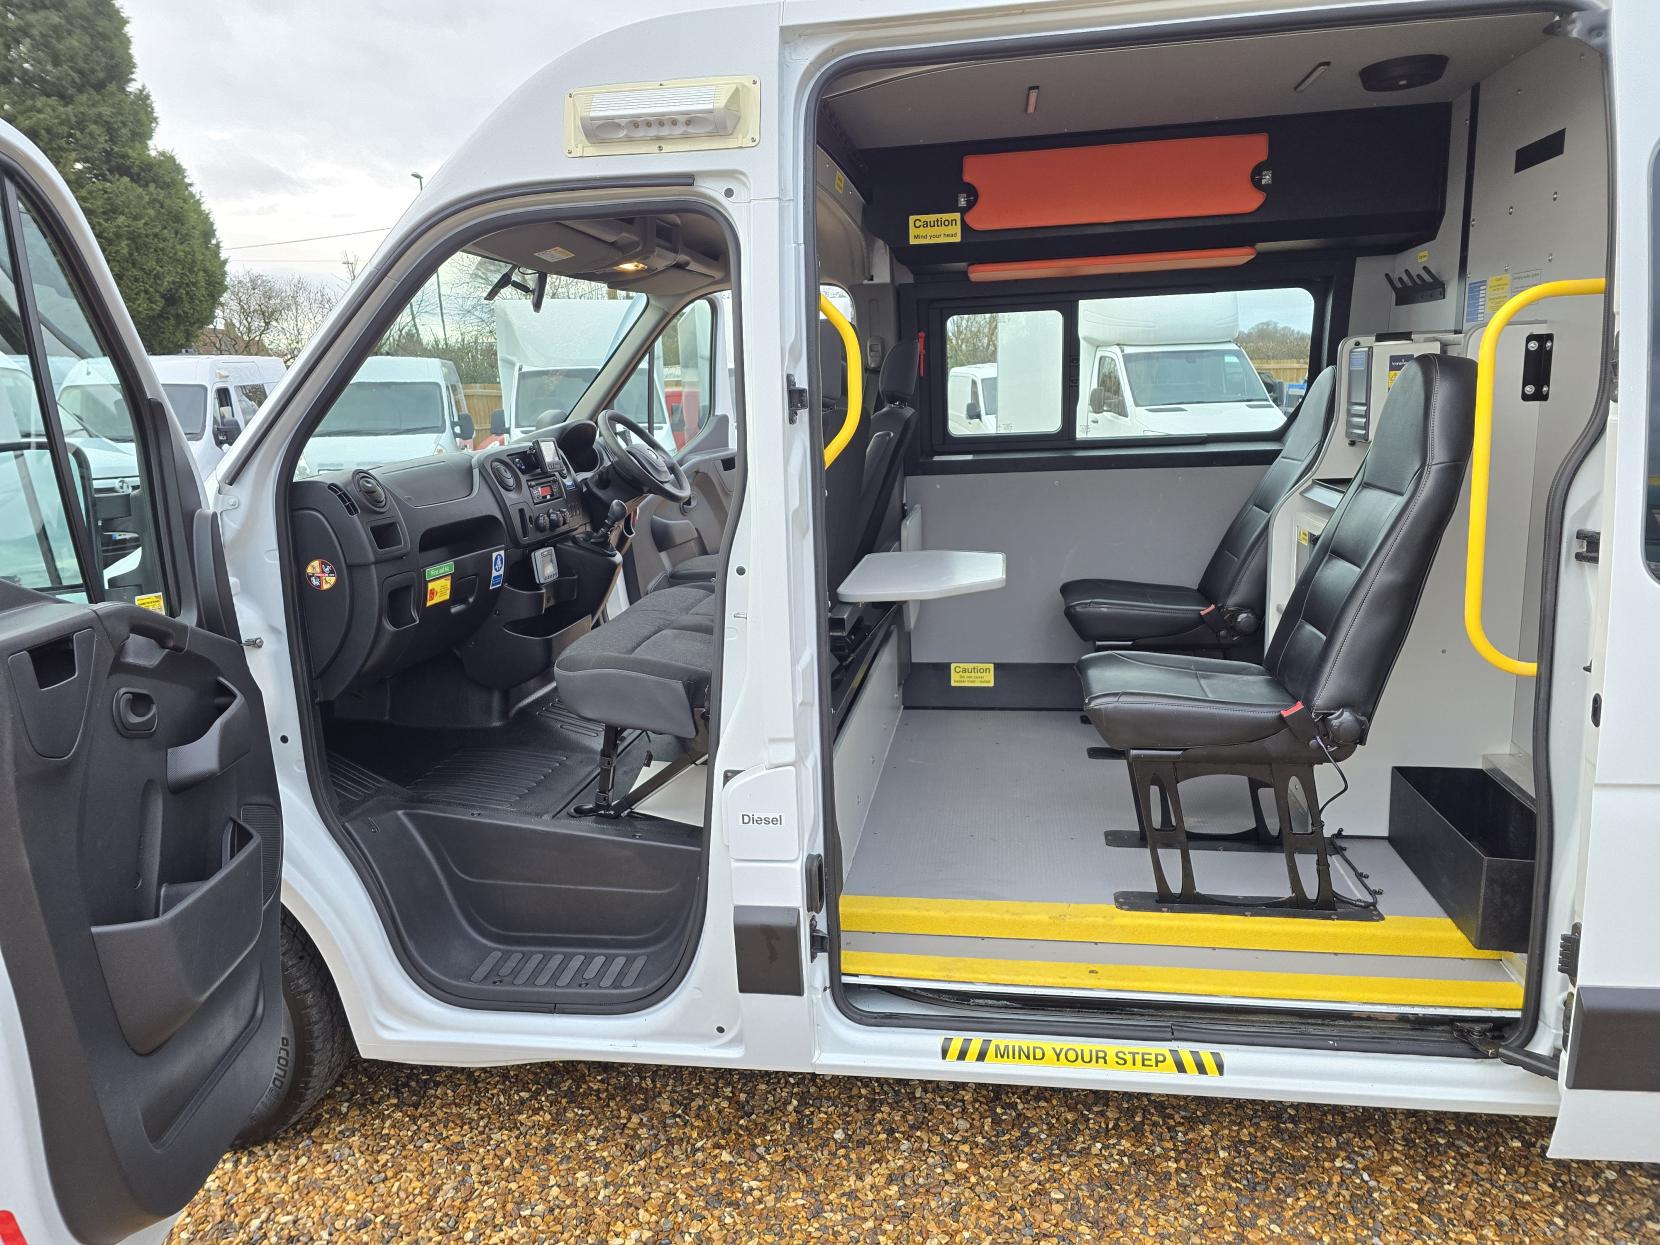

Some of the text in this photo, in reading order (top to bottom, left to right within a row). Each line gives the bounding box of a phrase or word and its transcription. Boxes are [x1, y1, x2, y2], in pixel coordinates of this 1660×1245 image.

[913, 217, 957, 229] Caution
[954, 665, 991, 674] Caution
[741, 813, 783, 826] Diesel
[994, 1044, 1167, 1068] MIND YOUR STEP
